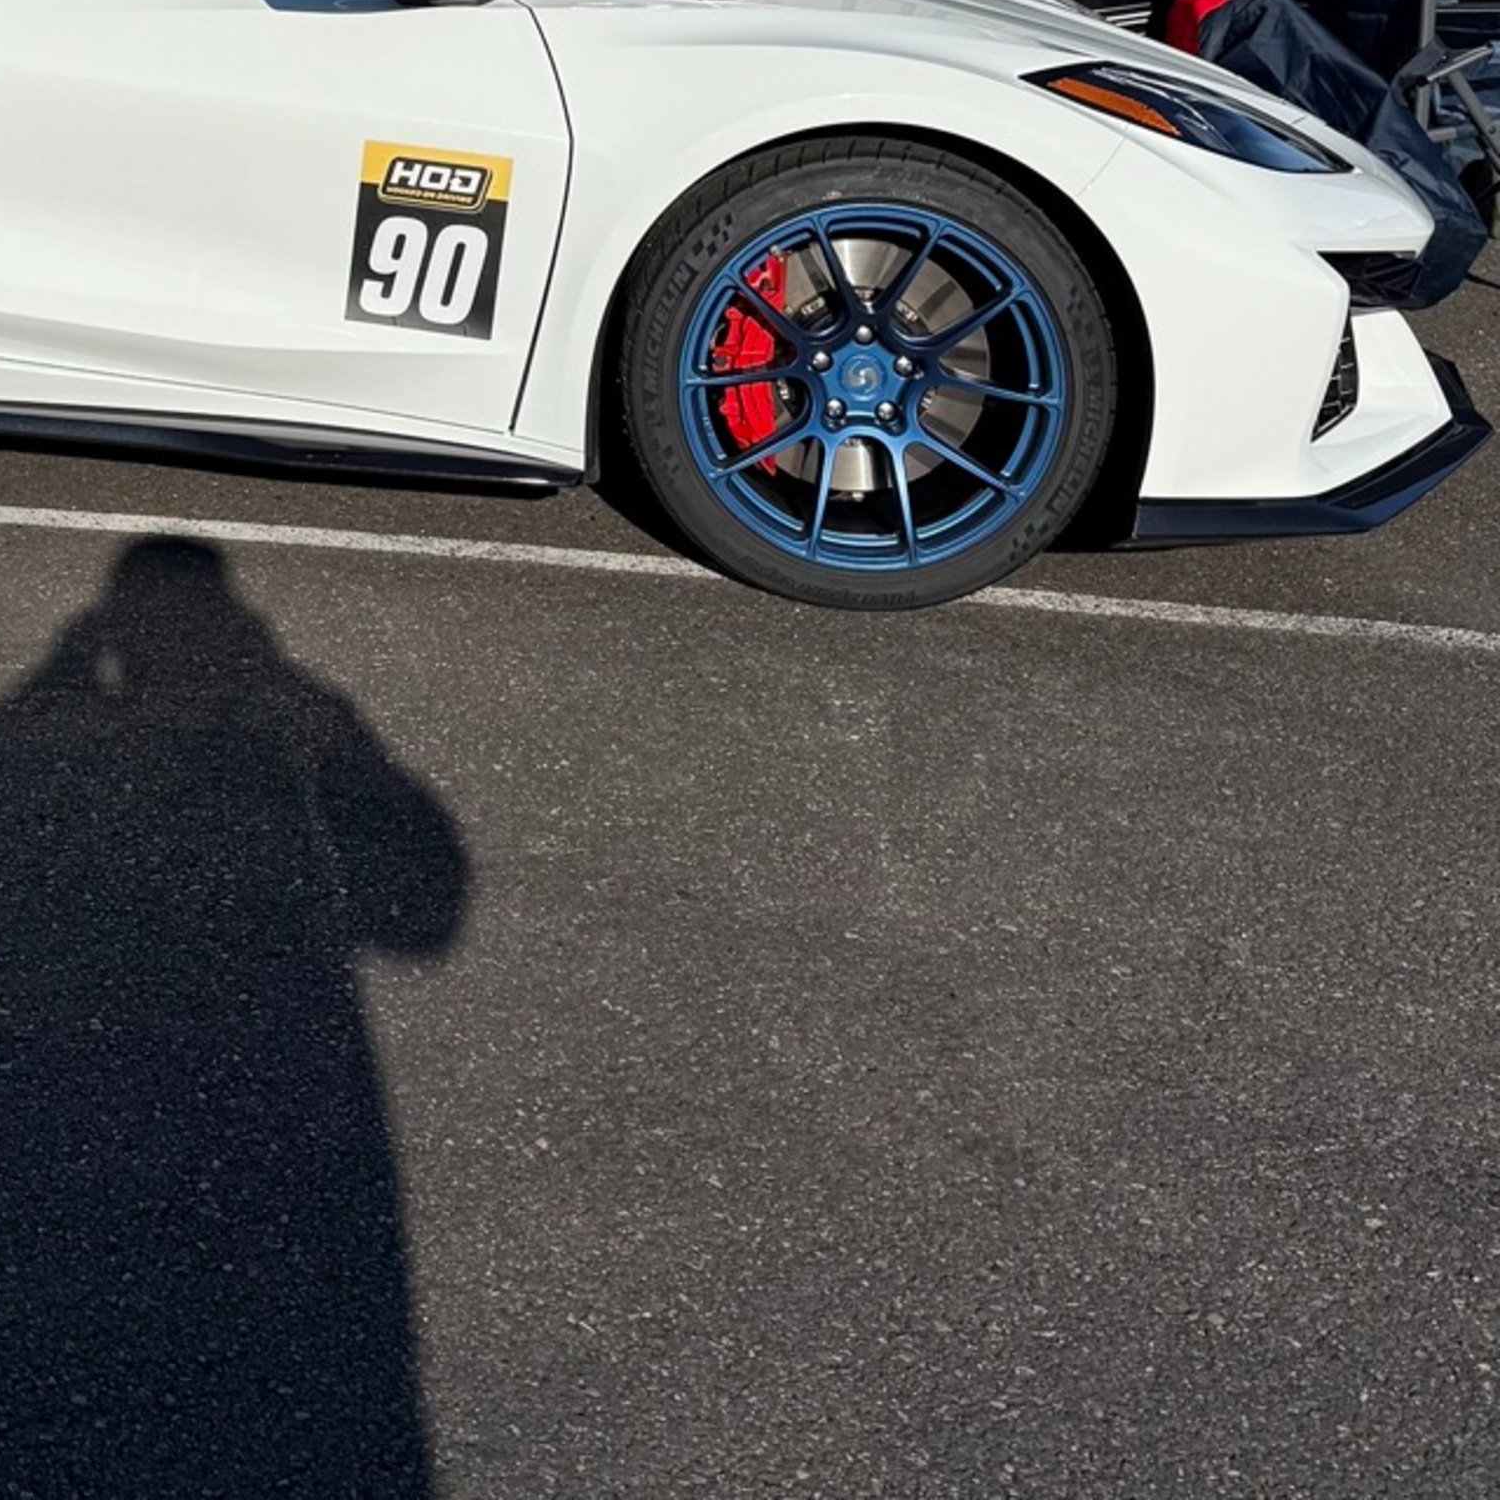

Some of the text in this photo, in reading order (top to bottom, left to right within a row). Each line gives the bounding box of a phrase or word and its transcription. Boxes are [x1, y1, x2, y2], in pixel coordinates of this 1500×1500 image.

[389, 161, 482, 194] HOD
[358, 215, 489, 325] 90
[643, 262, 693, 394] MICHELIN
[1051, 386, 1105, 514] MICHELIN
